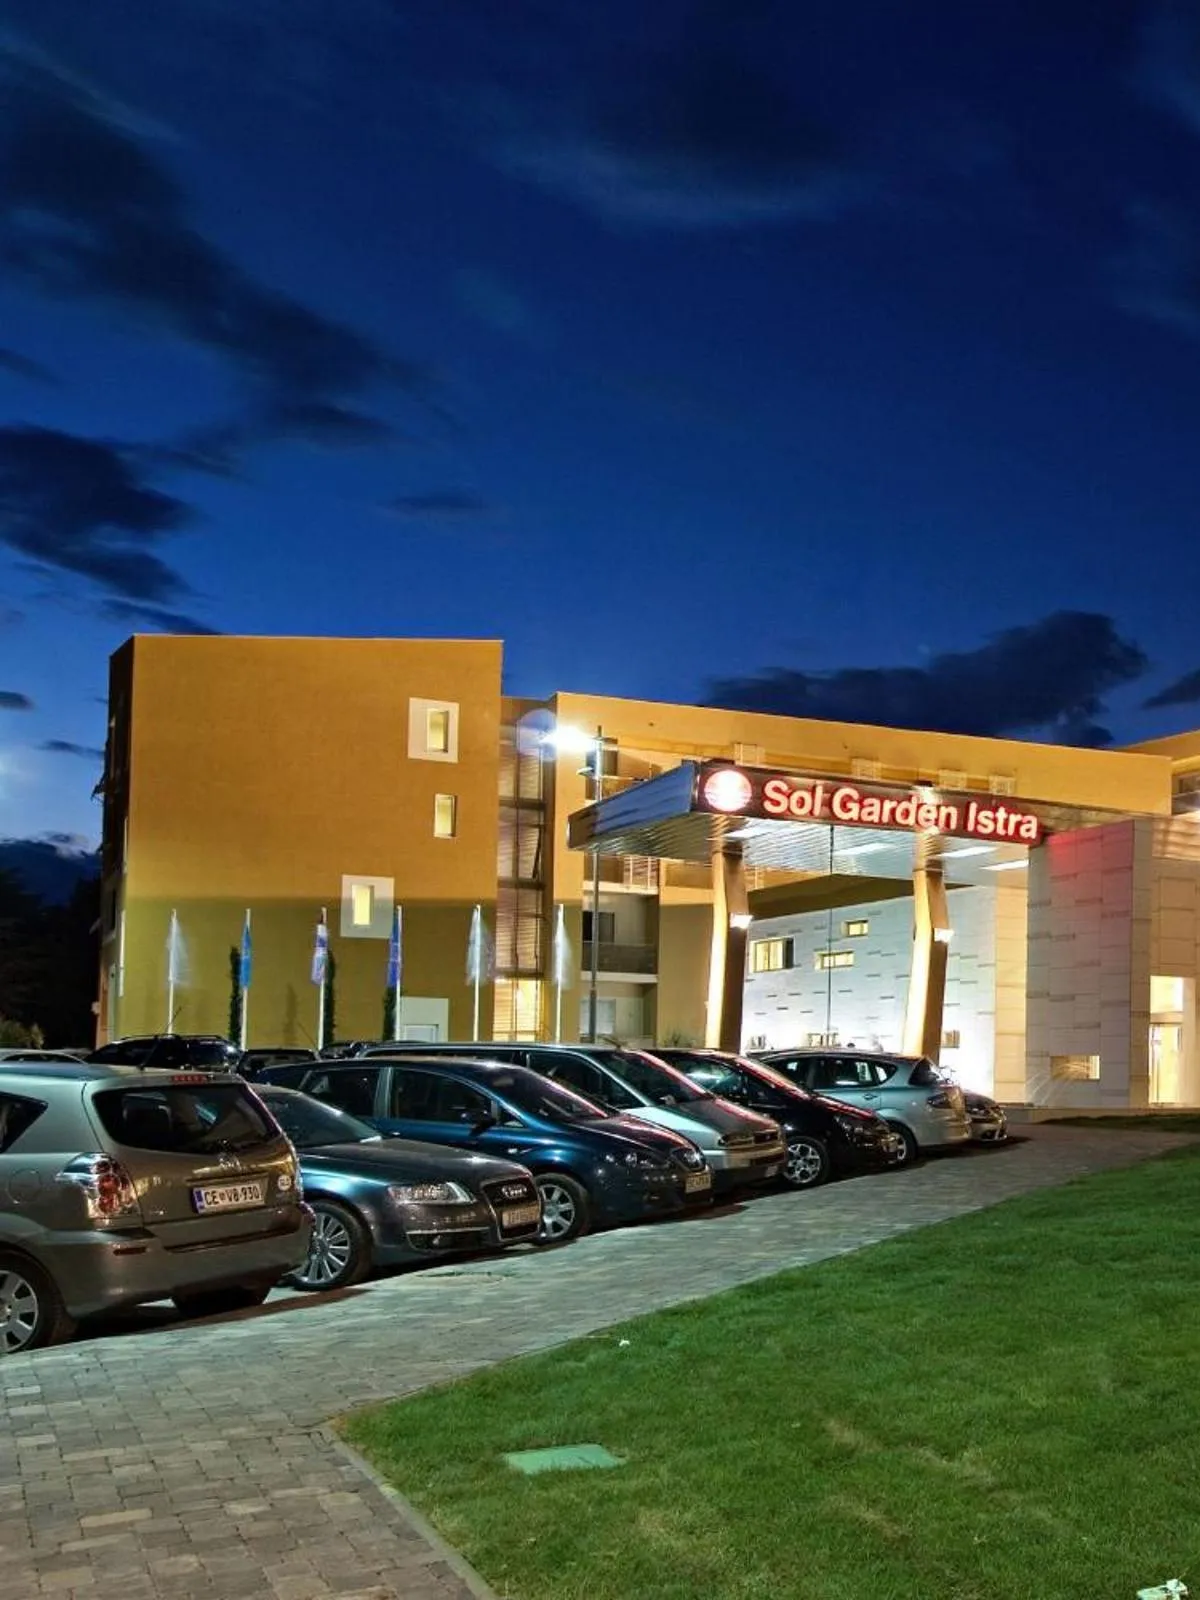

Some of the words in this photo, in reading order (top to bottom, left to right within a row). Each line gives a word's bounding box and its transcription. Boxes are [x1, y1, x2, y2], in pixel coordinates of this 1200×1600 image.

[763, 779, 823, 815] Sol
[832, 787, 958, 830] Garden
[967, 802, 1038, 839] Istra
